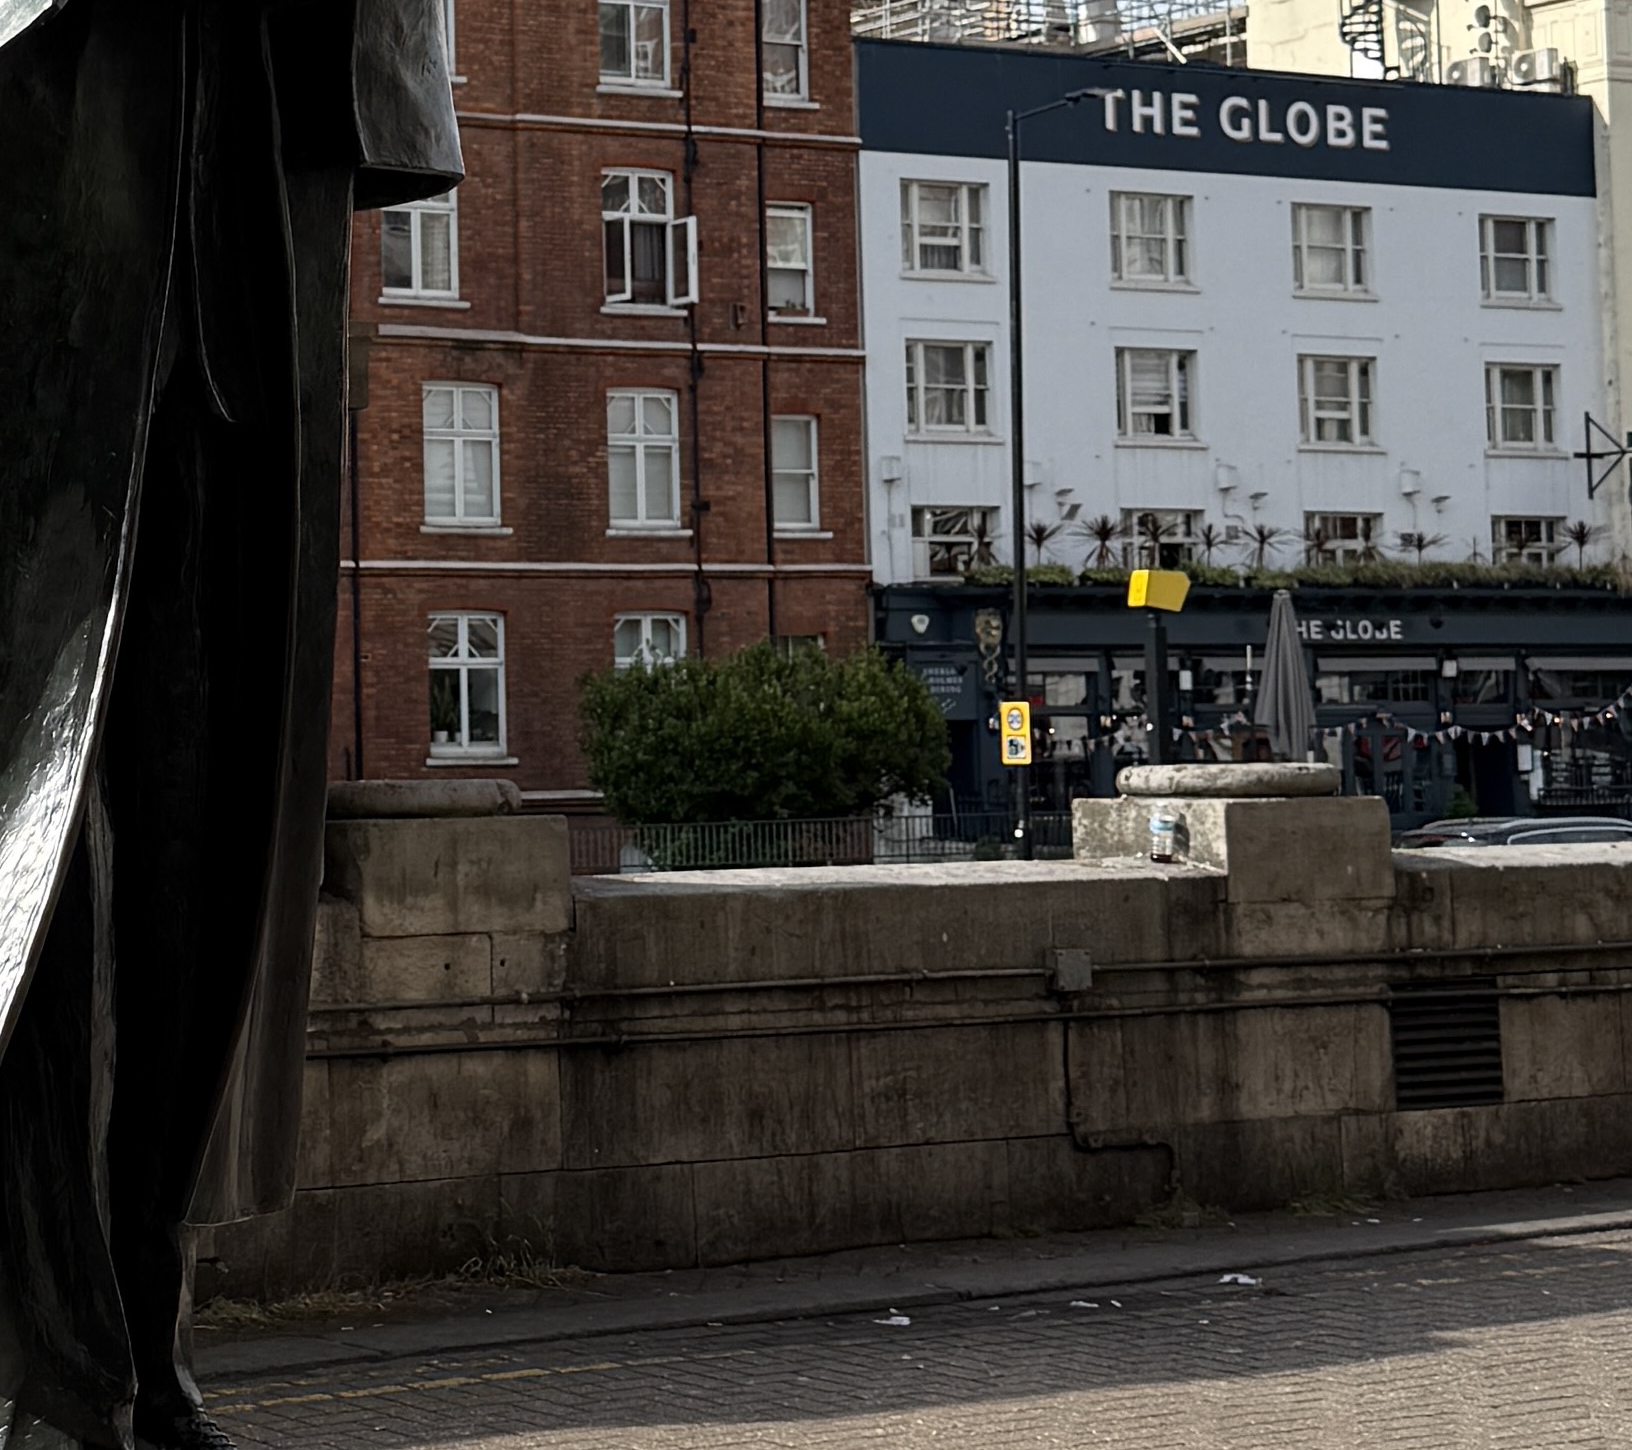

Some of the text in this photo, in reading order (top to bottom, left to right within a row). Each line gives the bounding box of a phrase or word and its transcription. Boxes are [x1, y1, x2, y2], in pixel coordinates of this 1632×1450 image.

[1104, 88, 1390, 151] THE GLOBE
[1295, 620, 1324, 640] HE
